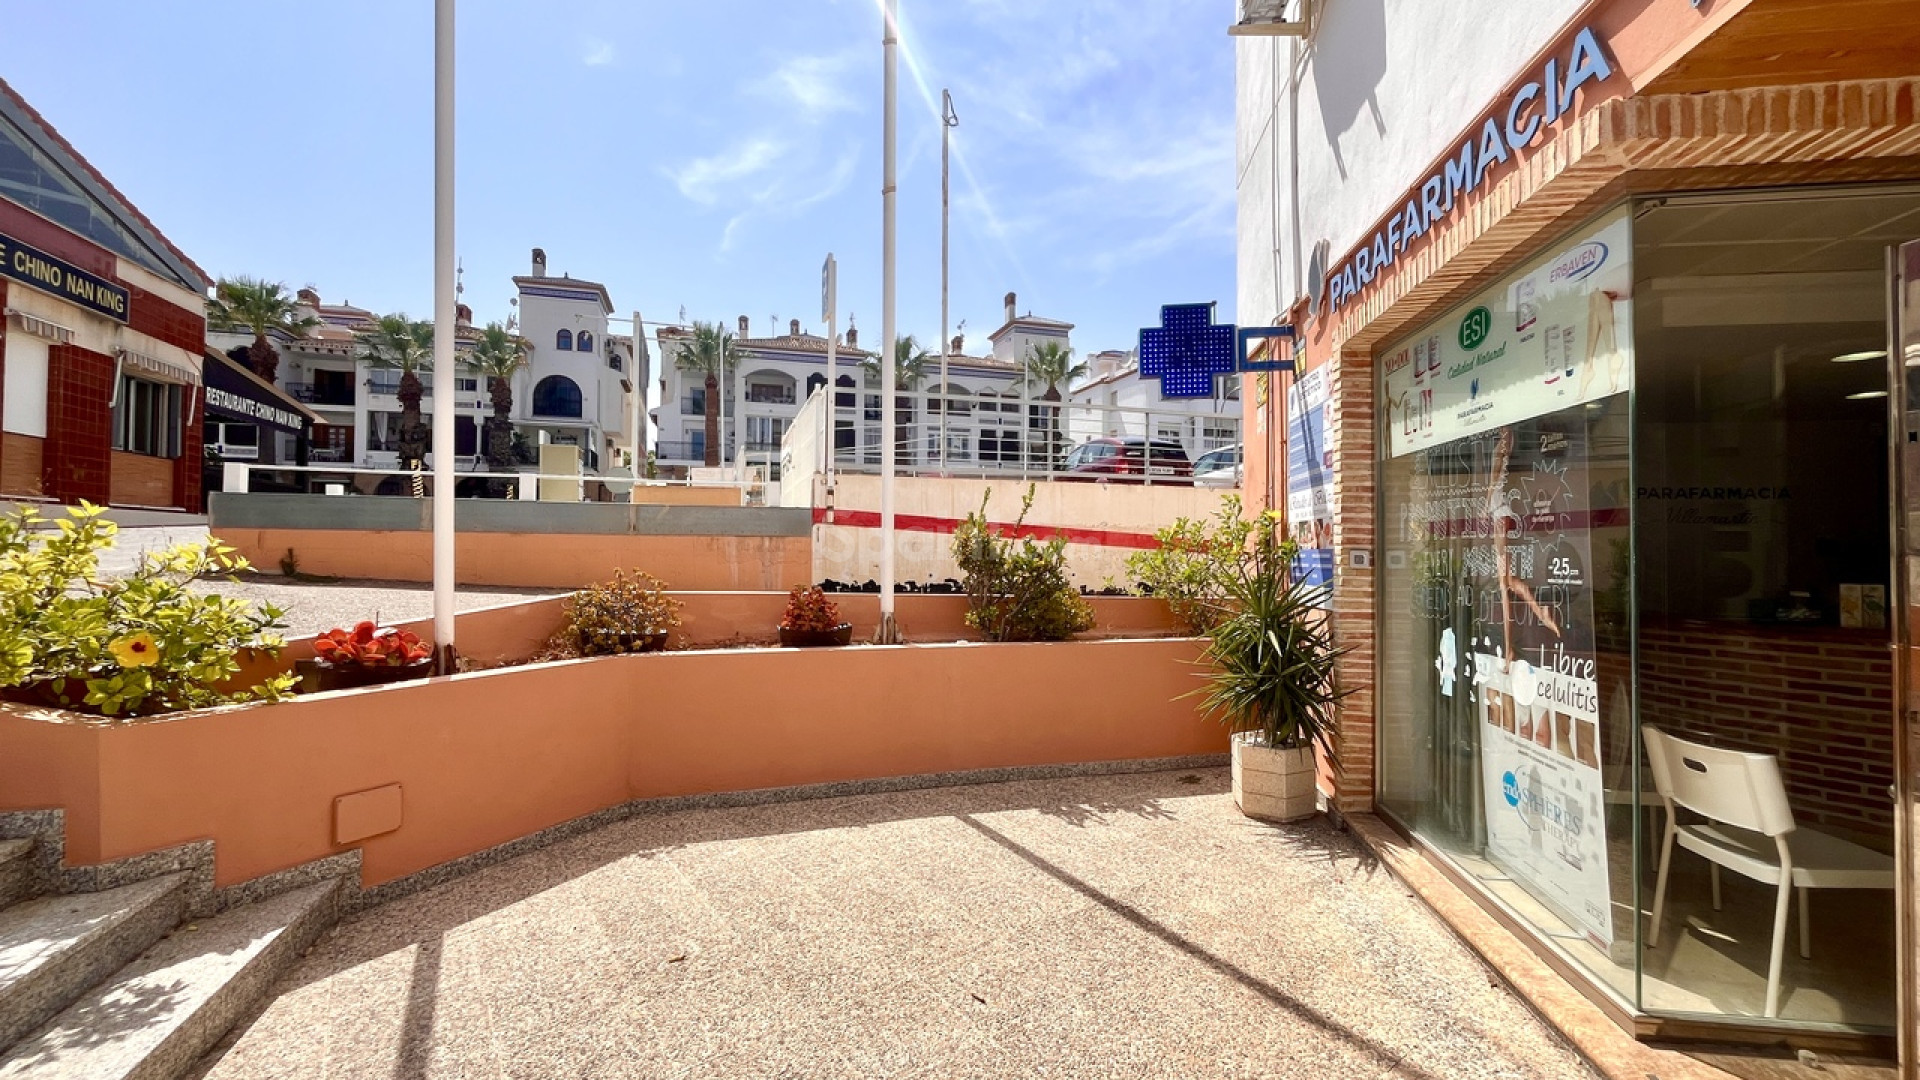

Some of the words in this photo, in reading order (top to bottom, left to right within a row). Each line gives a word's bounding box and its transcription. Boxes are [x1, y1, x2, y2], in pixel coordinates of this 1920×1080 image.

[1328, 27, 1612, 313] PARAFARMACIA
[14, 251, 61, 288] CHINO
[66, 273, 94, 301] NAN
[96, 287, 124, 313] KING
[1550, 245, 1597, 283] ERBAVEN
[1463, 309, 1487, 346] ESI
[1475, 340, 1507, 367] Natural
[206, 386, 255, 415] RESTAURANTE
[255, 402, 275, 422] CHINO
[275, 408, 289, 425] NAN
[288, 413, 303, 430] KING
[1636, 487, 1793, 500] PARAFARMACIA
[1540, 642, 1595, 680] Libre
[1537, 677, 1597, 713] celulitis
